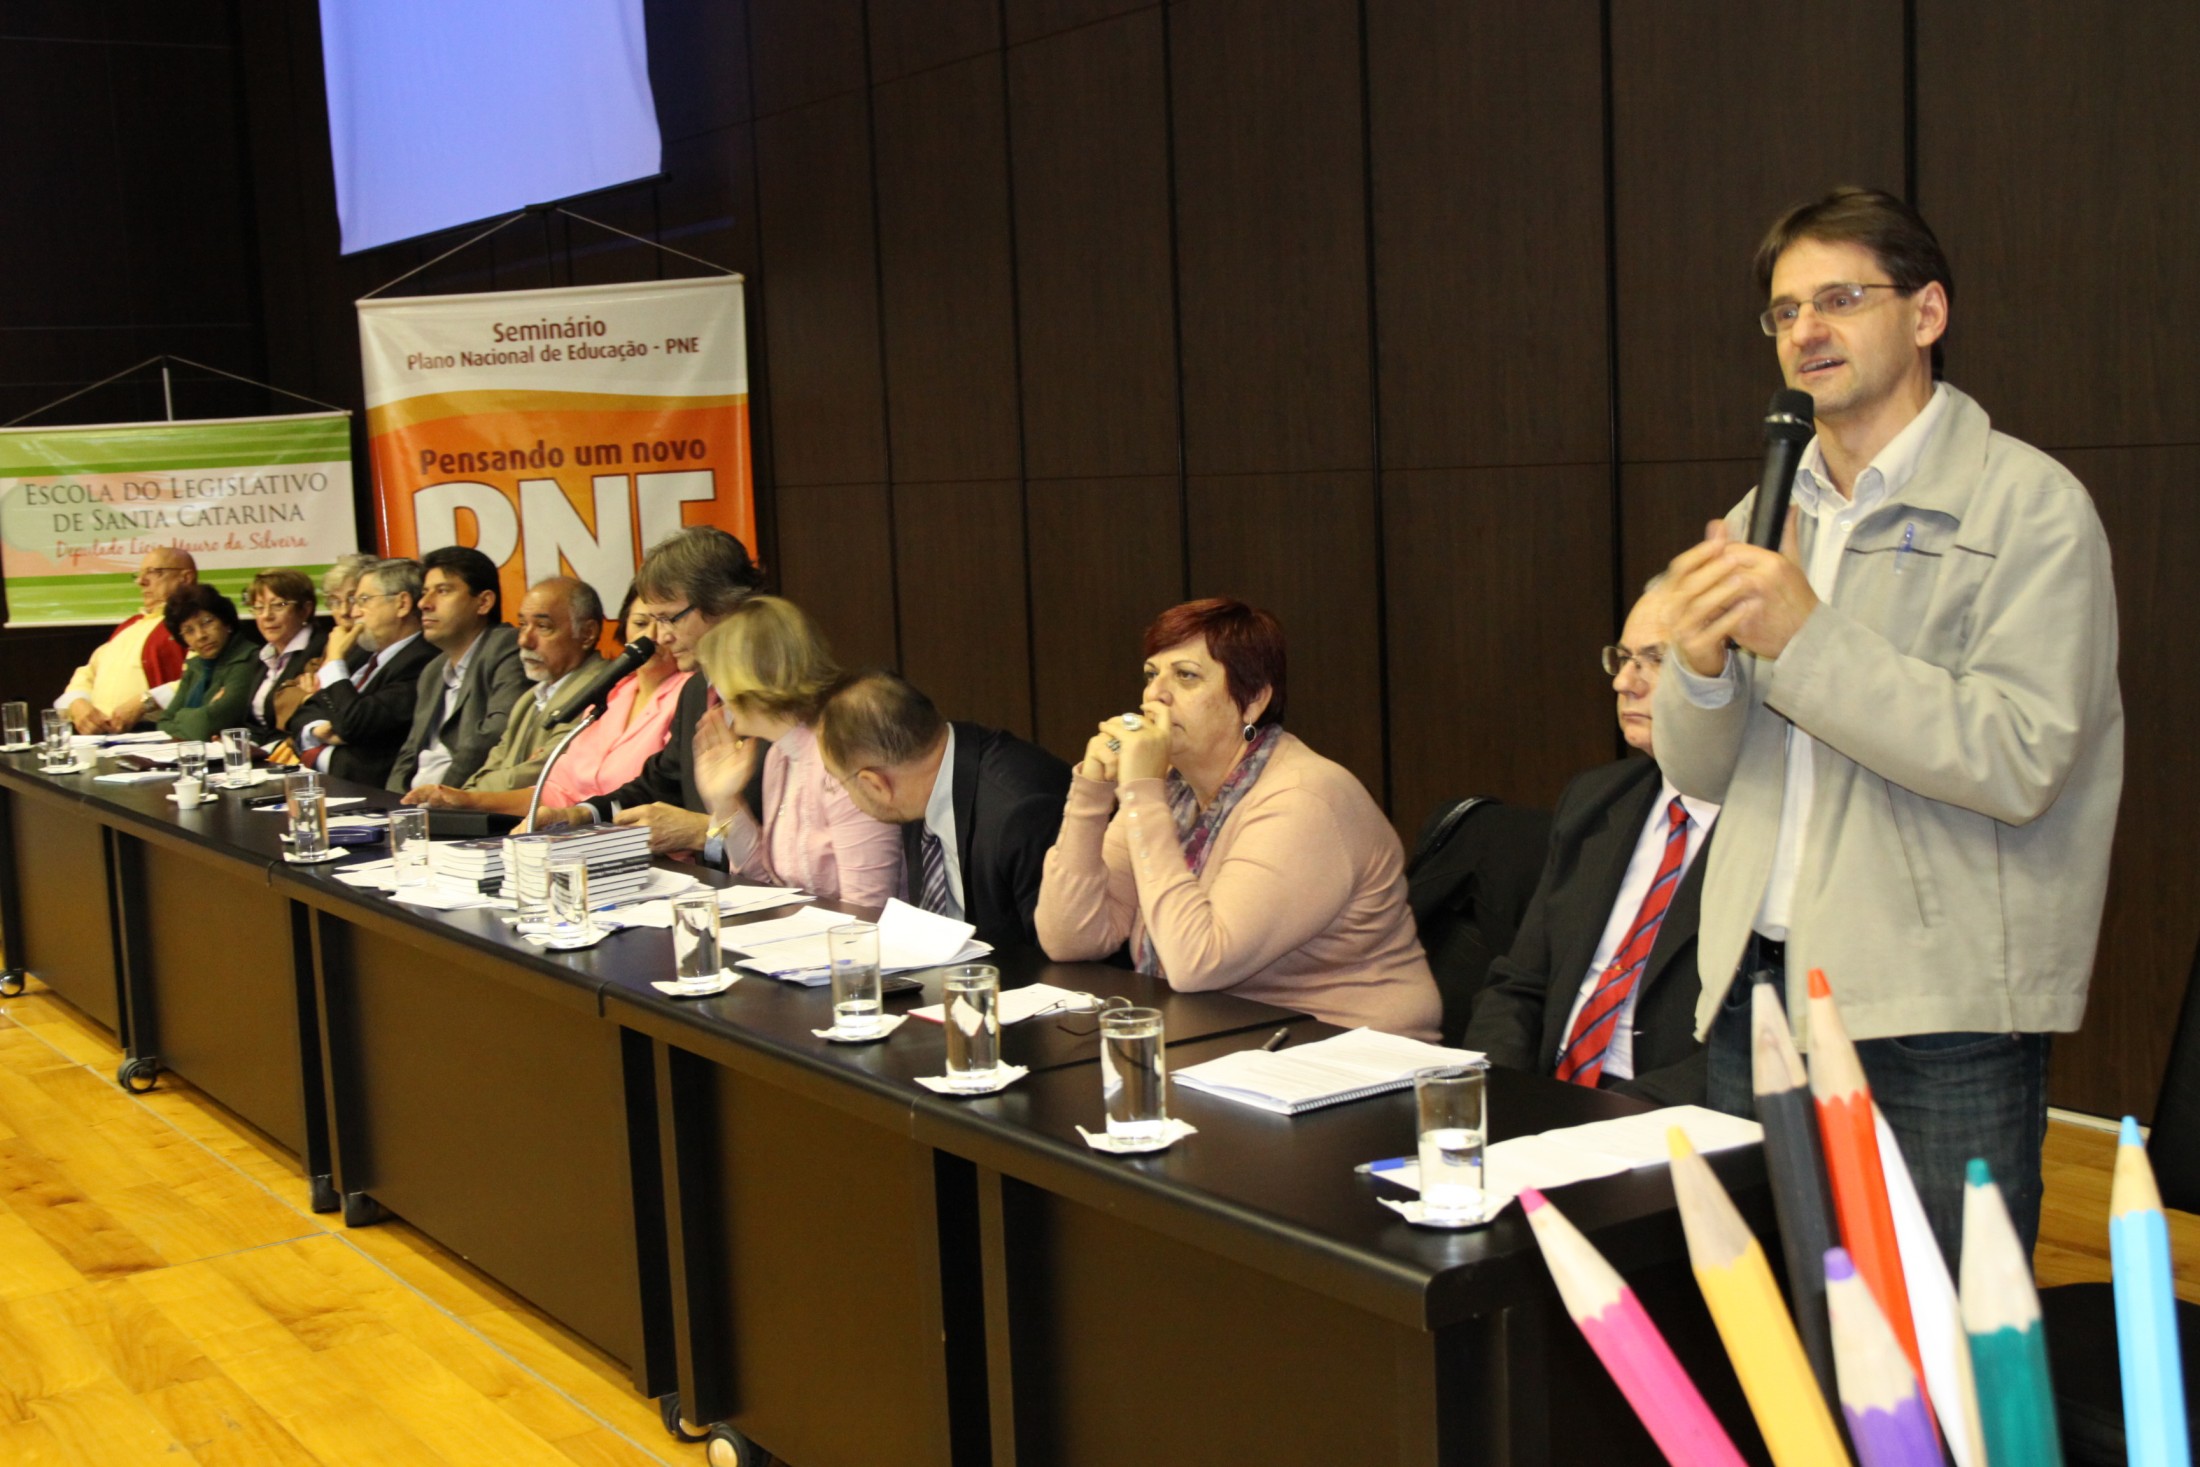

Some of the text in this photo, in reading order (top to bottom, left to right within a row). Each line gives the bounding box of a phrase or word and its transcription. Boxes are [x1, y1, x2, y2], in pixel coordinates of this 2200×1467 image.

[493, 315, 607, 343] Seminário
[407, 353, 455, 371] Plano
[460, 345, 535, 367] Nacional
[540, 345, 561, 362] de
[567, 340, 649, 362] Educação
[664, 336, 701, 354] PNE
[419, 439, 707, 474] Pensando um novo
[25, 472, 328, 506] ESCOLA DO LEGISLATIVO
[53, 502, 305, 533] DE SANTA CATARINA
[223, 532, 245, 551] da
[248, 529, 309, 550] Silveira
